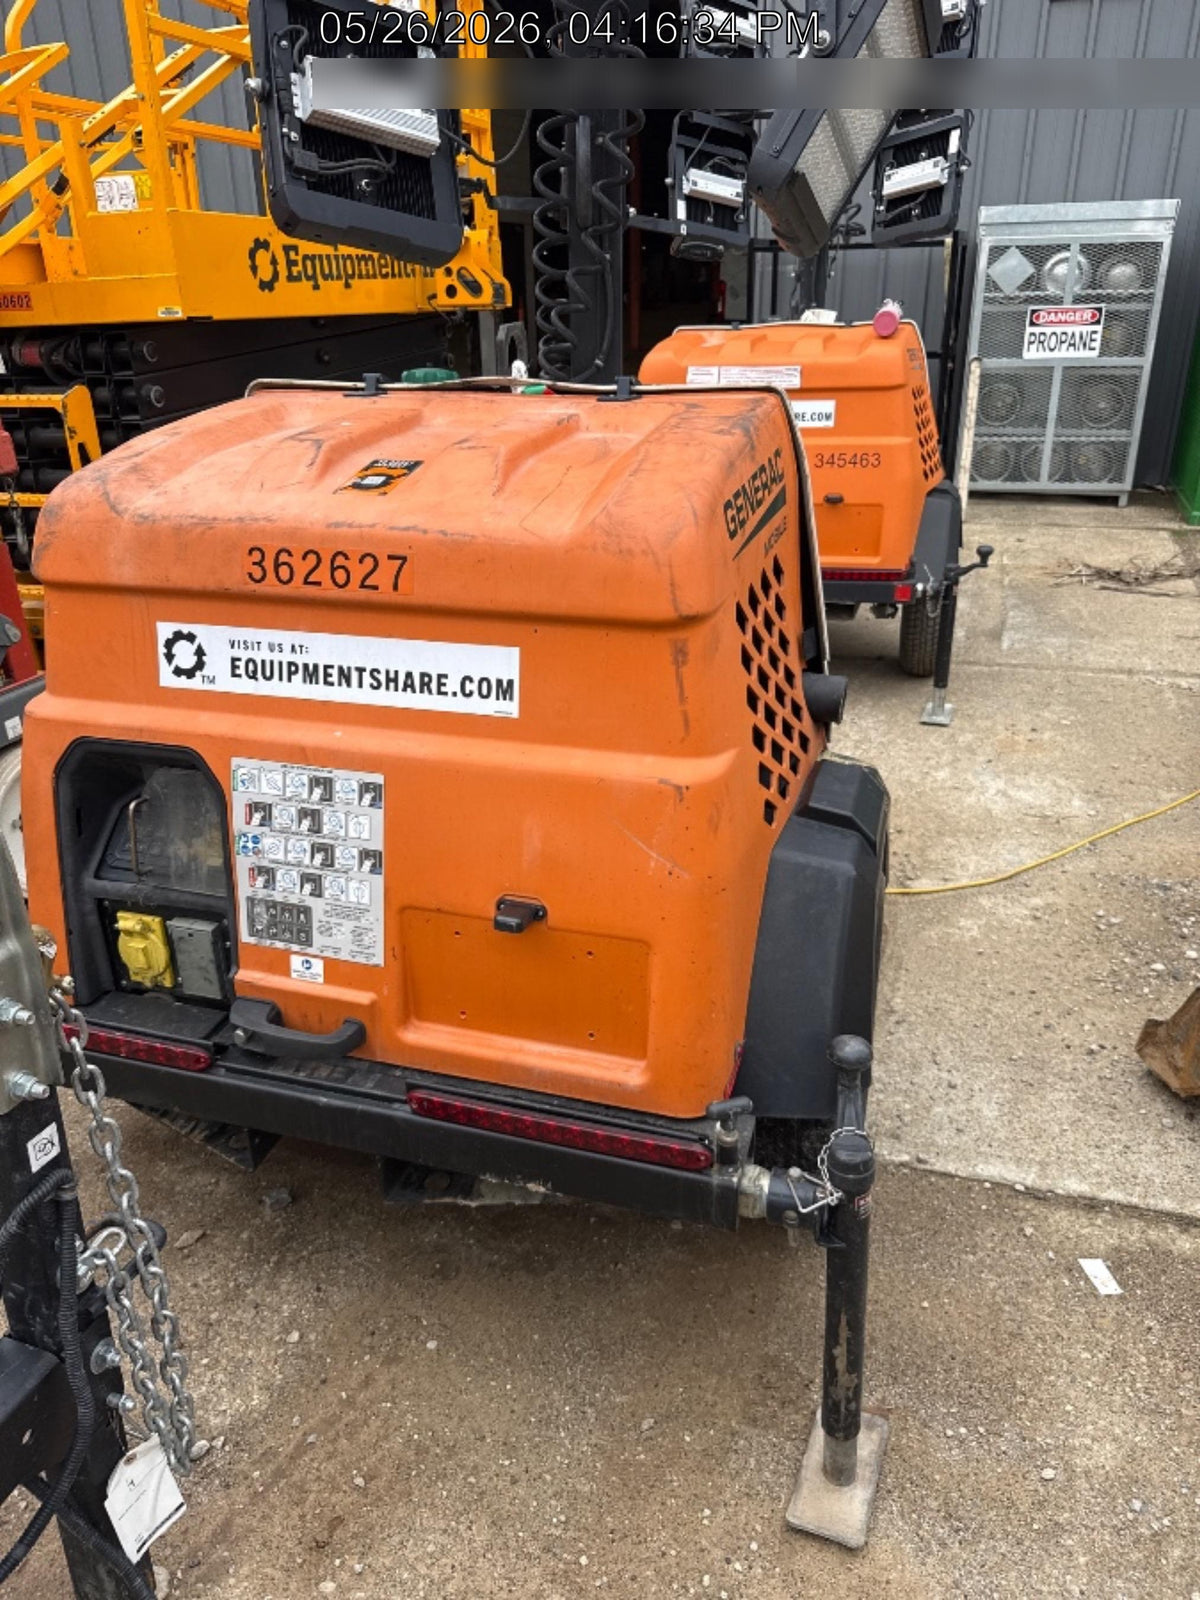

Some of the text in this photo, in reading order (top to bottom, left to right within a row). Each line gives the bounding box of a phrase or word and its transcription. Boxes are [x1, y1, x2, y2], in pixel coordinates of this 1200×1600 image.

[0, 294, 31, 309] 0602
[1038, 308, 1094, 323] DANGER
[1026, 330, 1099, 353] PROPANE
[813, 452, 881, 469] 345463
[723, 447, 785, 541] GENERAC
[246, 546, 408, 592] 362627
[228, 638, 310, 656] VISIT US AT:
[200, 674, 216, 686] TM
[229, 655, 515, 703] EQUIPMENTSHARE.COM
